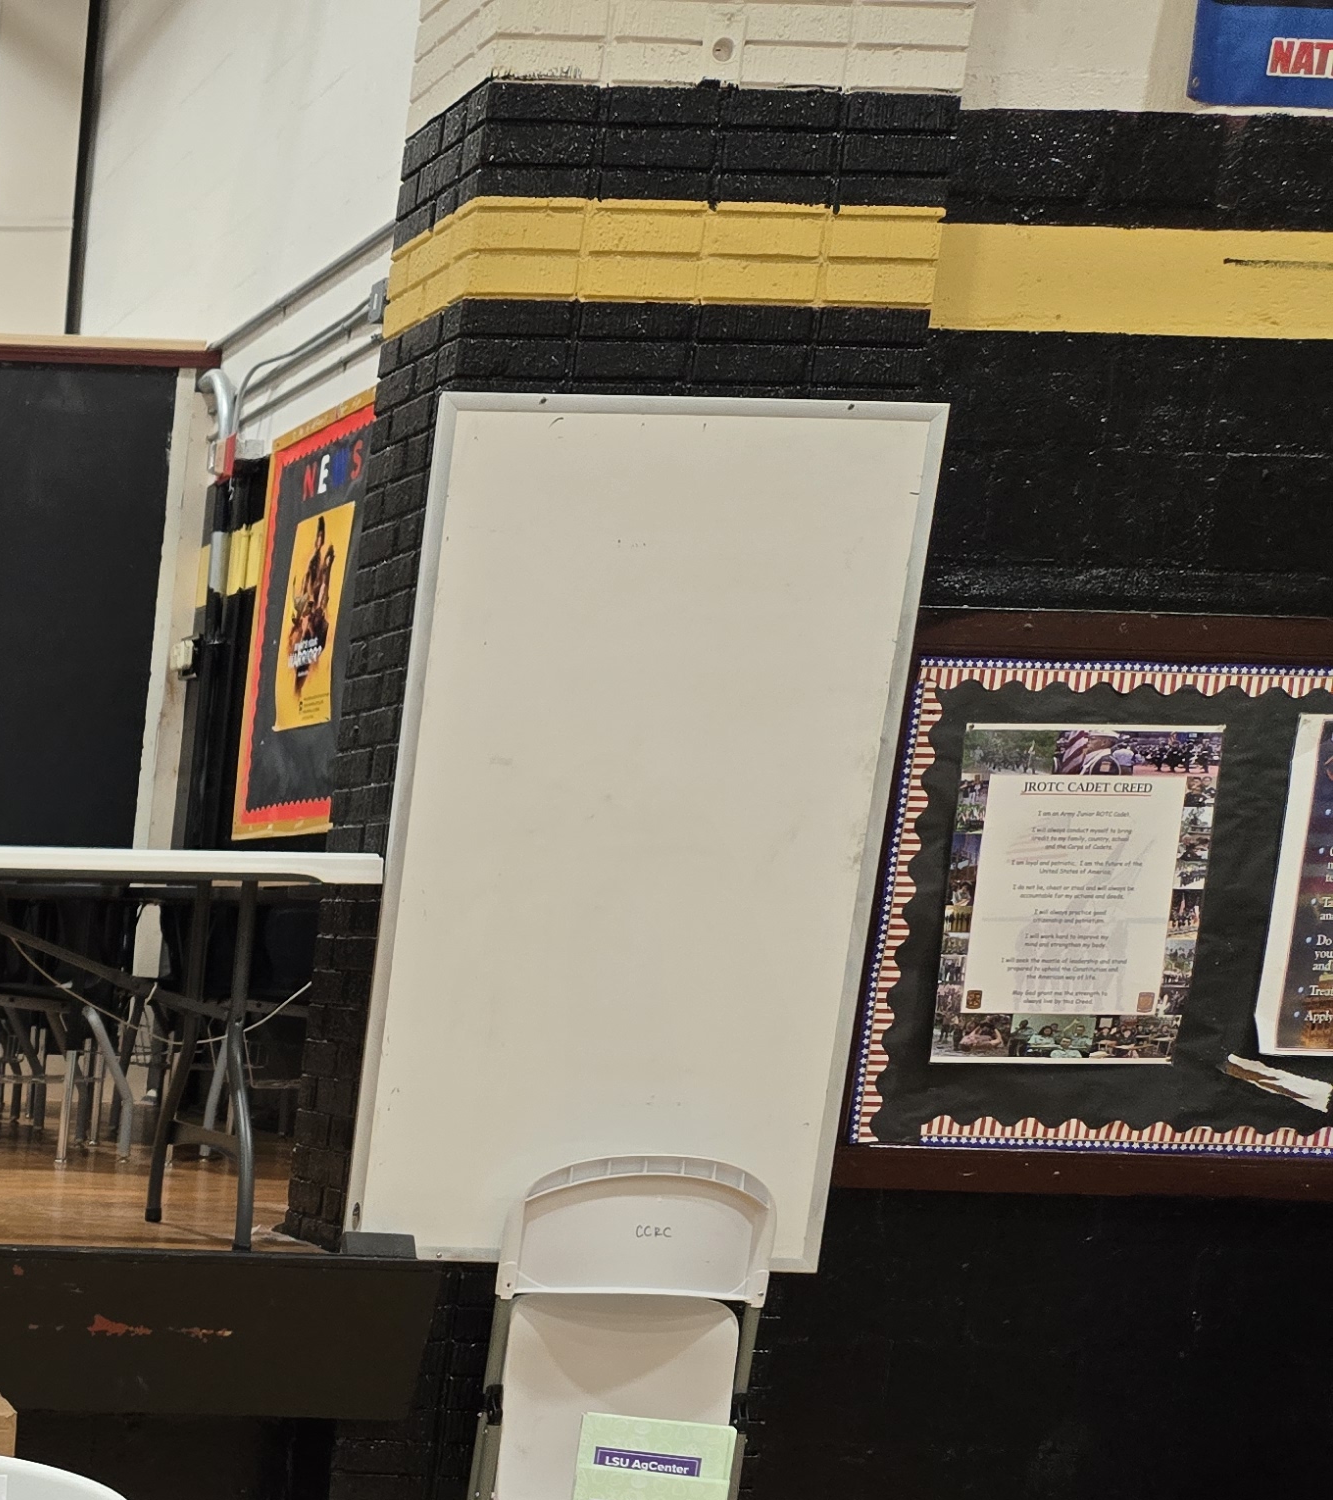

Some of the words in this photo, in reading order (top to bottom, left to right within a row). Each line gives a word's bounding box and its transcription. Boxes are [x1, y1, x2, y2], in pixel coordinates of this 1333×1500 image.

[302, 440, 363, 501] NEWS
[1024, 781, 1065, 793] JROTC
[1068, 782, 1111, 793] CADET
[1113, 782, 1153, 794] CREED
[636, 1225, 672, 1238] CCRC
[605, 1456, 629, 1467] LSU
[632, 1459, 689, 1475] AgCenter
